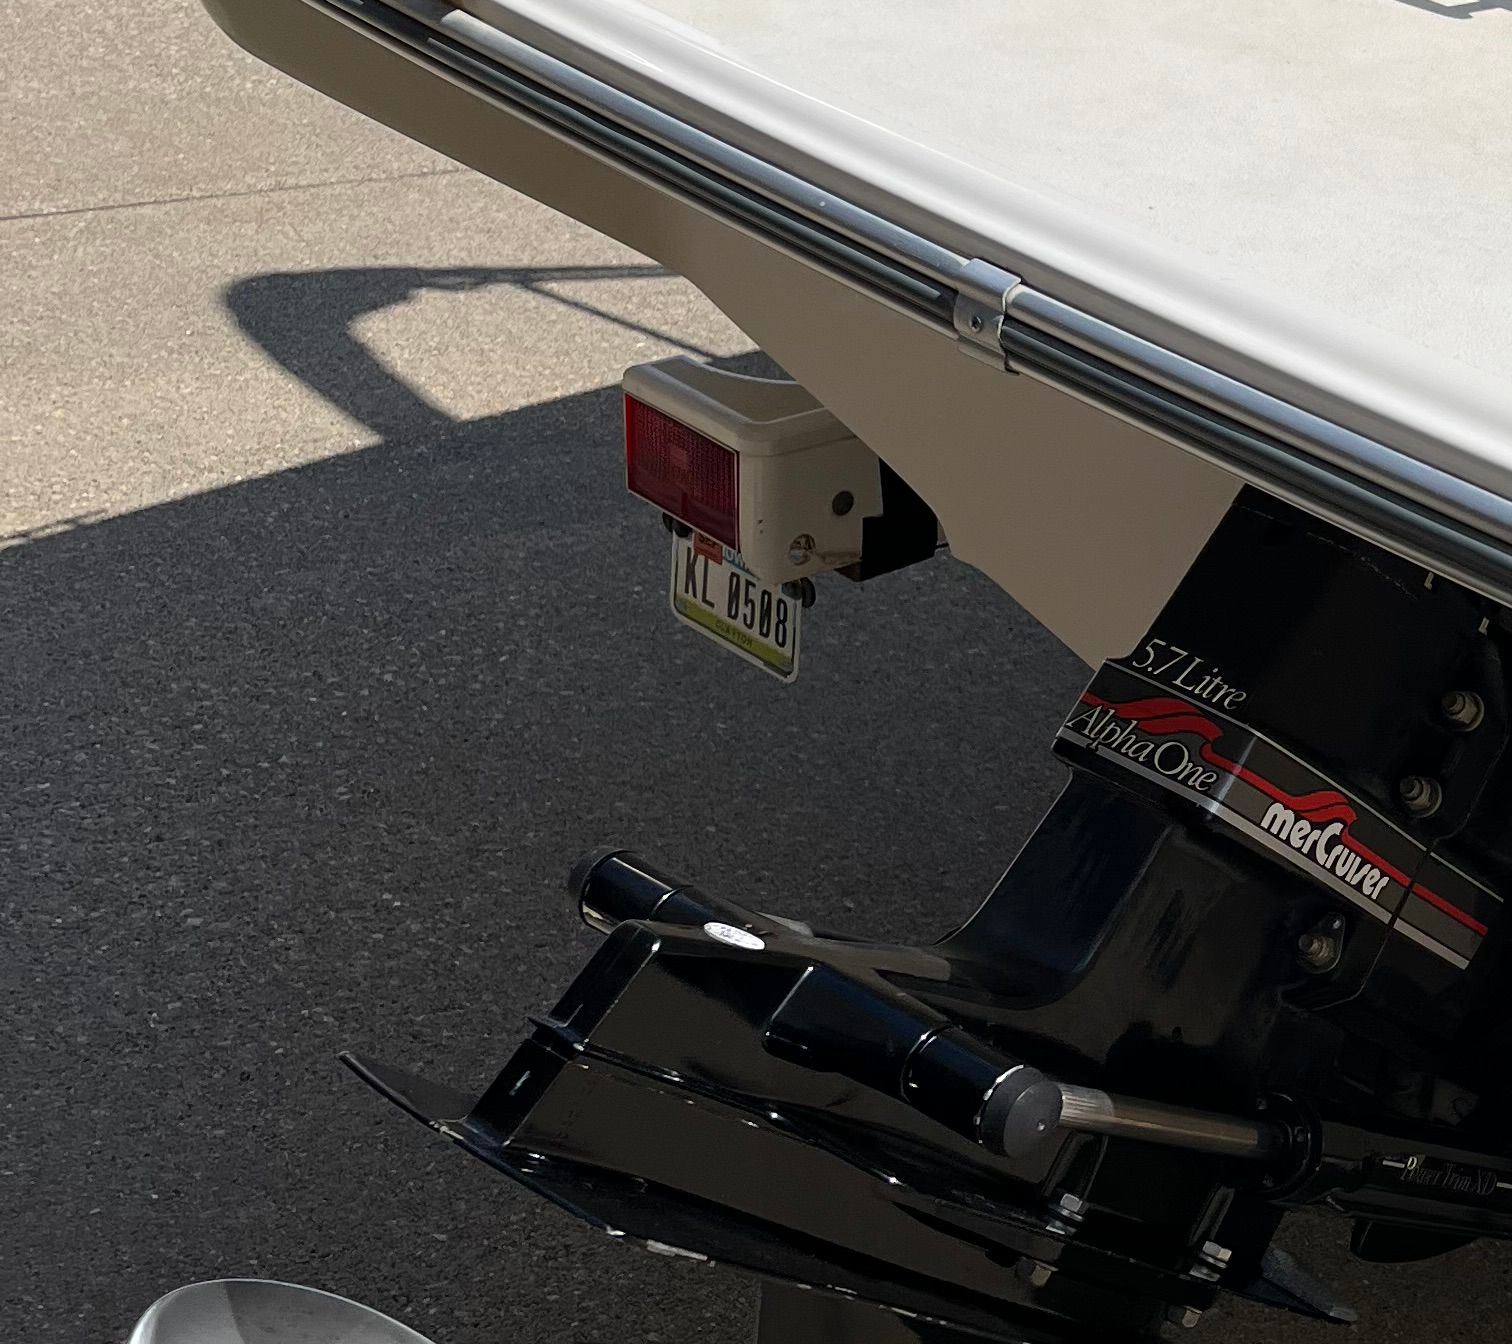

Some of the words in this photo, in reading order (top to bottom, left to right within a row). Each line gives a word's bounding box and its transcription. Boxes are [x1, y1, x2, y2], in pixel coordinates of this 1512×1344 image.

[684, 547, 715, 609] KL
[727, 571, 788, 648] 0508
[1132, 637, 1188, 685] 5.7
[1173, 656, 1248, 711] Litre
[1066, 704, 1155, 763] Alpha
[1153, 741, 1217, 792] One
